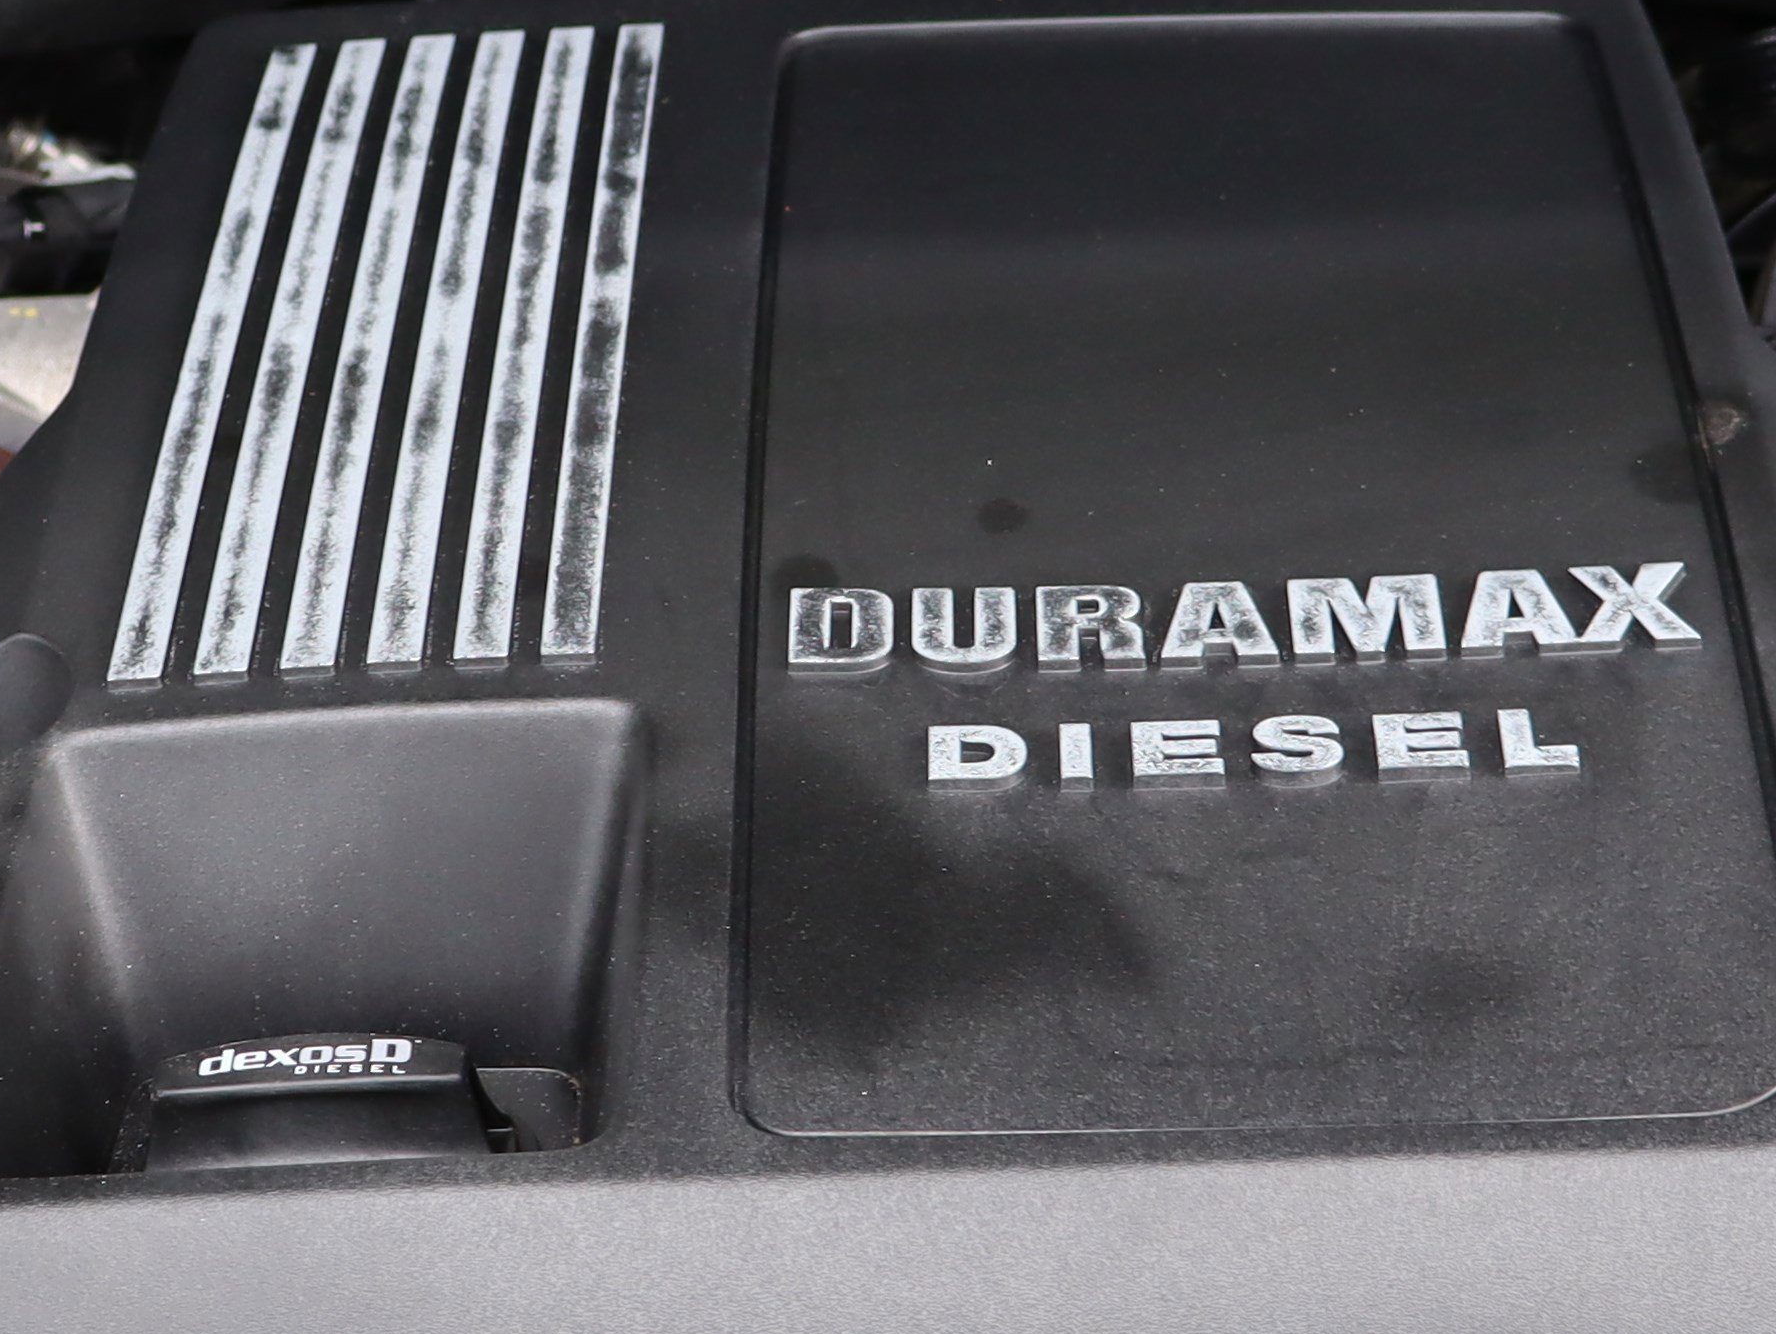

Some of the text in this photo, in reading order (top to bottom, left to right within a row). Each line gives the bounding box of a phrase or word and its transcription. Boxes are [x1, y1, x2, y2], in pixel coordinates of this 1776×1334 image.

[787, 561, 1702, 671] DURAMAX
[926, 708, 1580, 790] DIESEL
[293, 1063, 407, 1075] DIESEL
